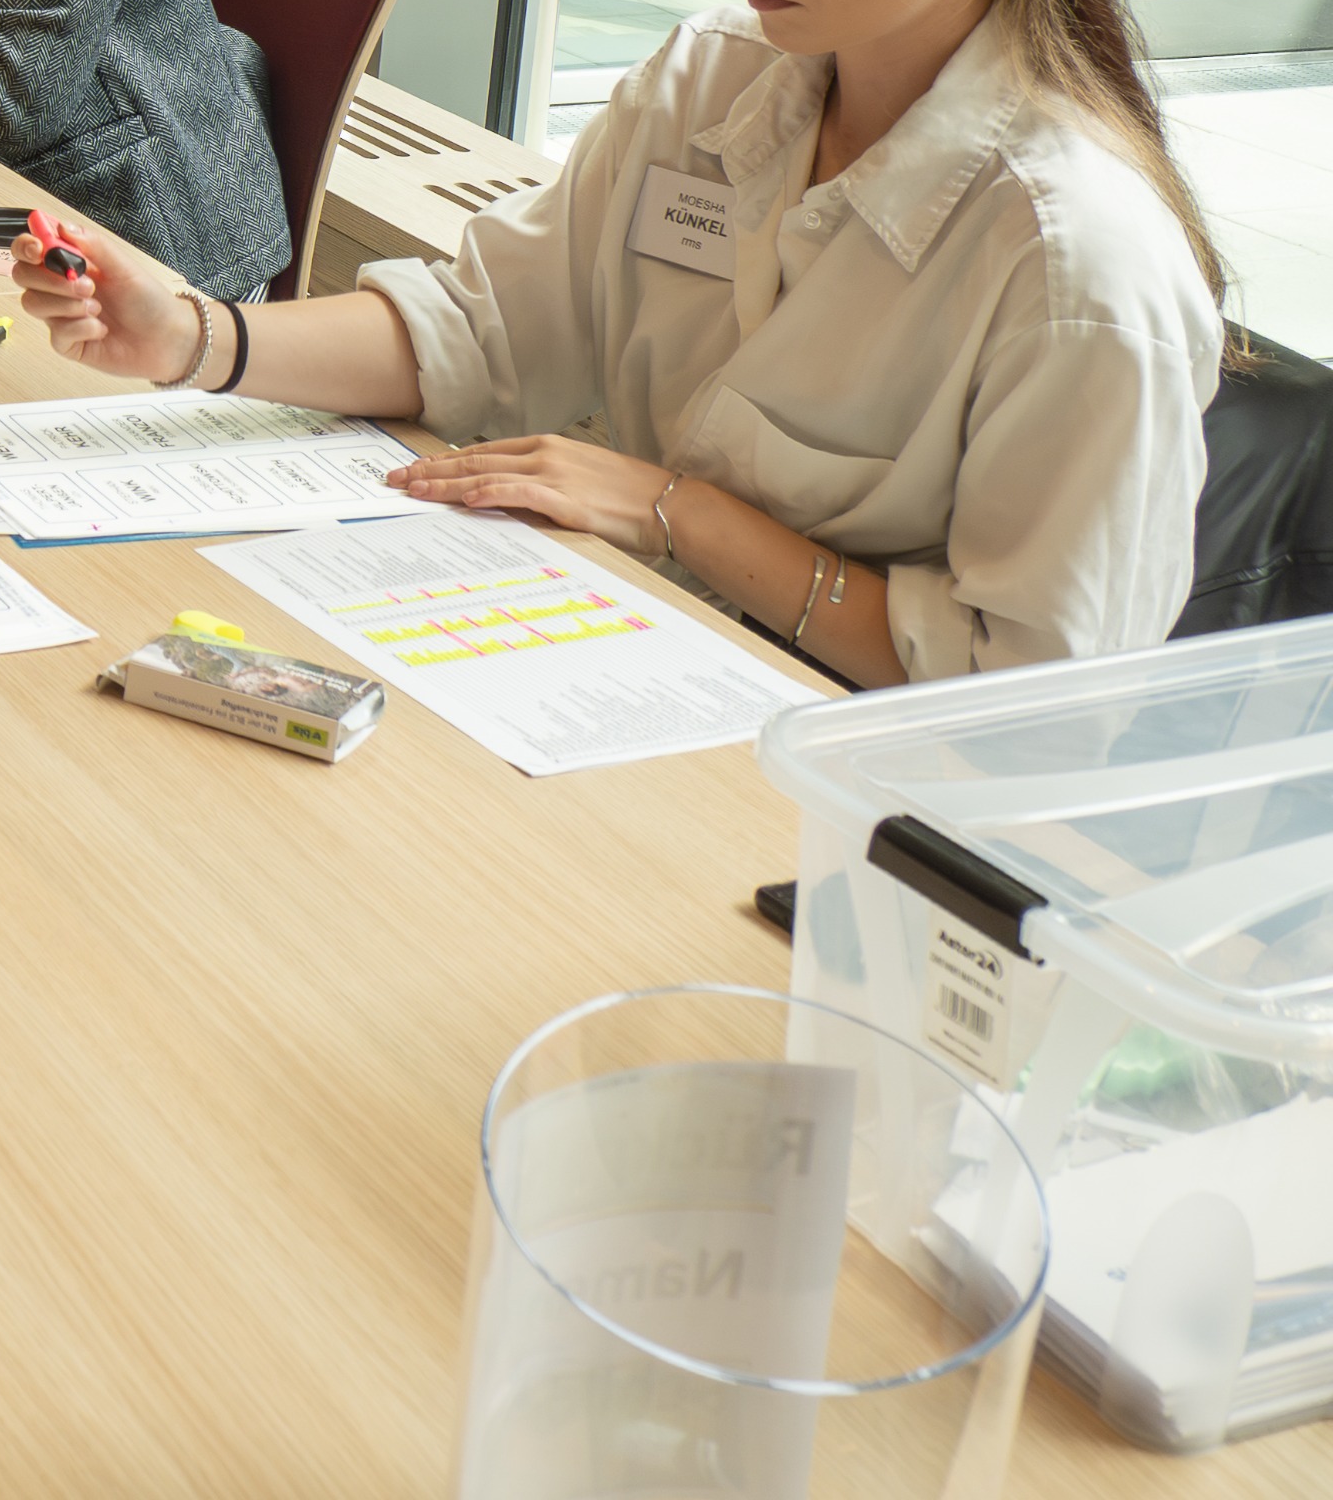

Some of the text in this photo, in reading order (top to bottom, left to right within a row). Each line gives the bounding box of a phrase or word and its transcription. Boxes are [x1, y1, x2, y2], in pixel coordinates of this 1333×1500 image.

[678, 192, 726, 215] MOESHA
[664, 206, 728, 238] KÜNKEL
[681, 236, 702, 250] rms
[121, 414, 175, 447] FRANZOI
[194, 408, 246, 440] GETTMANN
[52, 426, 90, 447] KEHR
[269, 459, 322, 492] WASMUTH
[350, 457, 393, 480] RBAT
[119, 480, 158, 501] WINK
